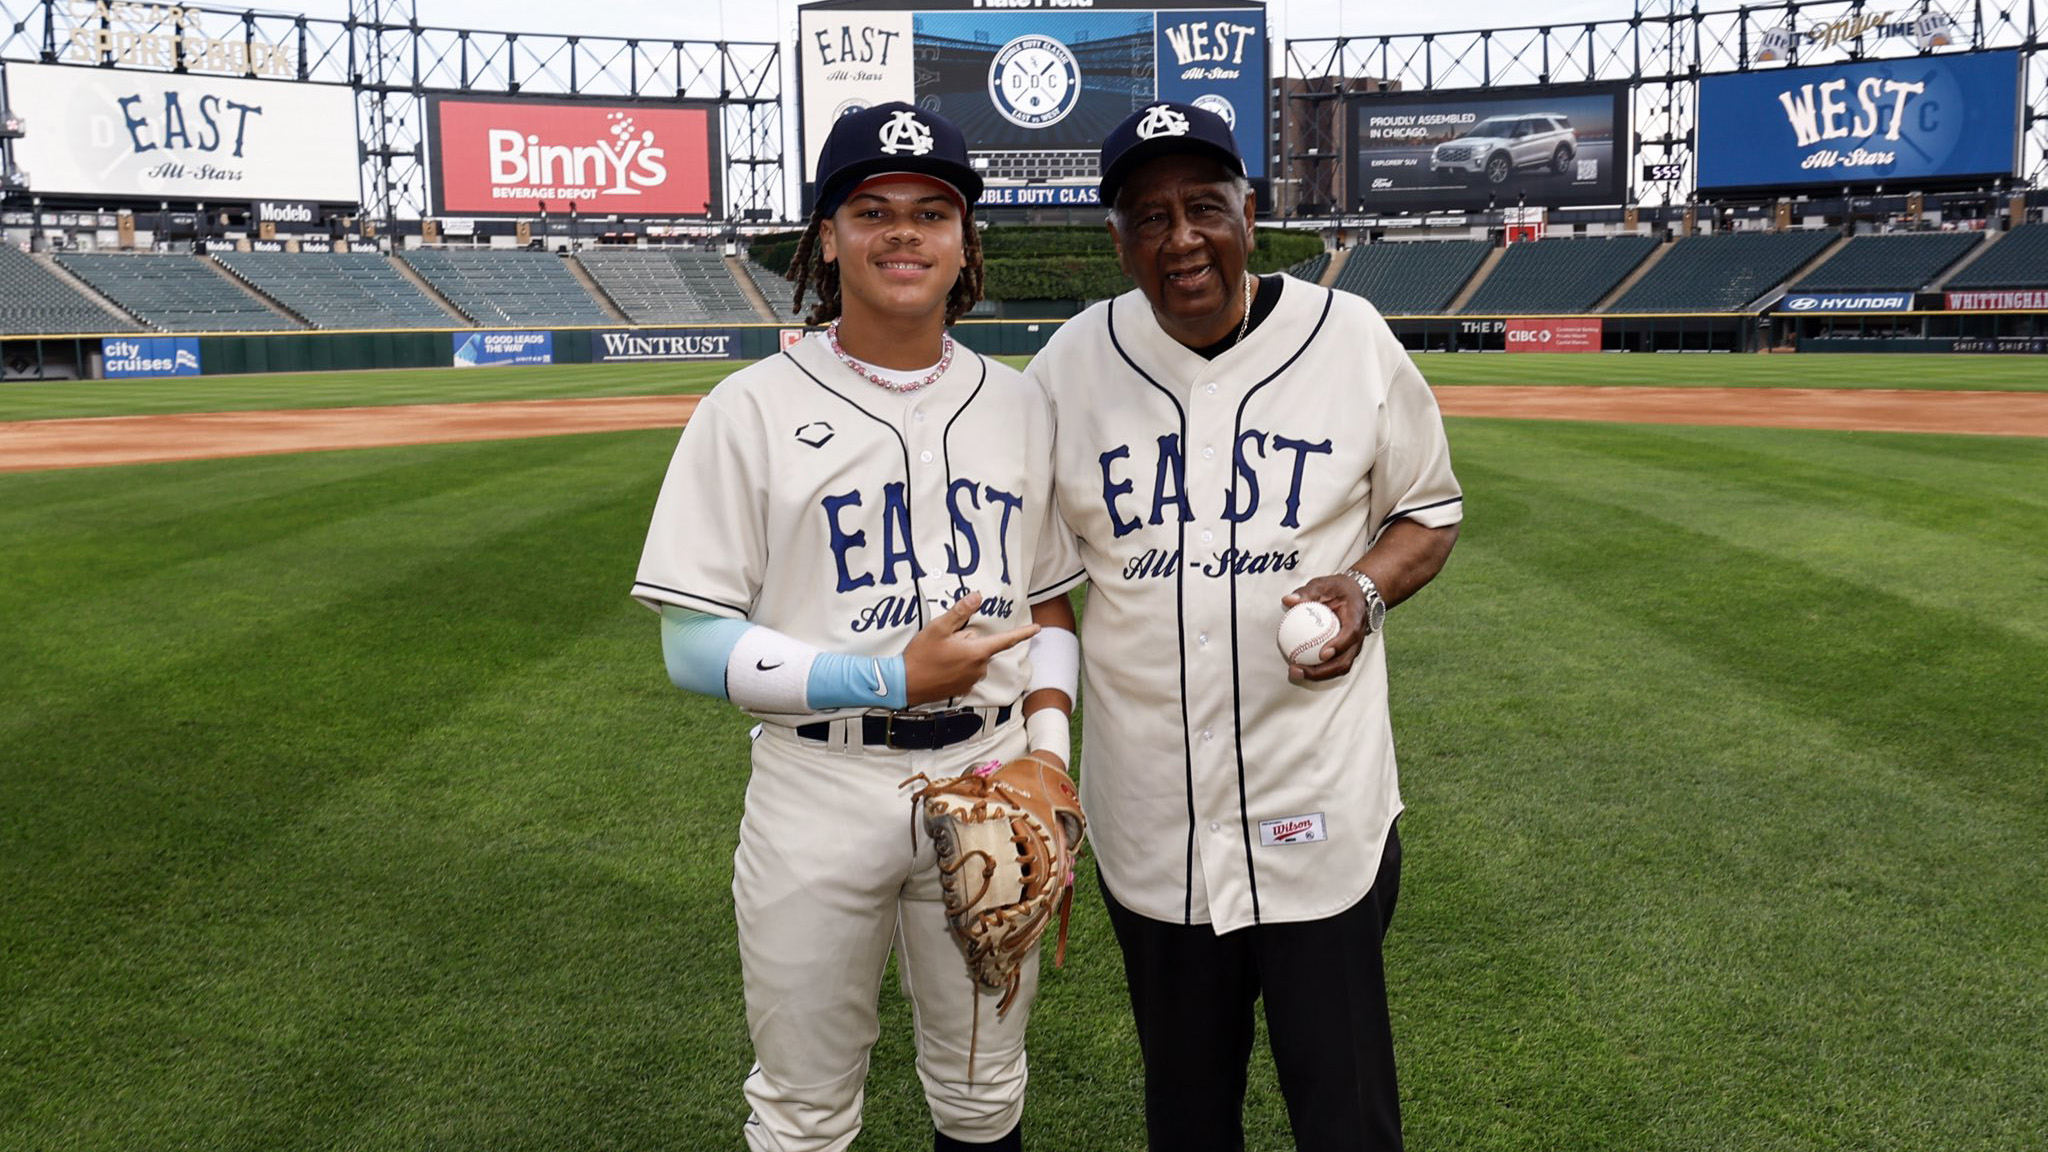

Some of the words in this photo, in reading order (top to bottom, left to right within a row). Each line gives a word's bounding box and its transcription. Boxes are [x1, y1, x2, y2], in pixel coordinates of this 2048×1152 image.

[67, 0, 203, 29] CAESARS
[1808, 10, 1895, 52] Miller
[1877, 21, 1915, 39] TIME
[70, 27, 296, 77] SPORTSBOOK
[815, 25, 900, 66] EAST
[1165, 21, 1256, 66] WEST
[826, 70, 883, 81] All-Stars
[1181, 67, 1240, 80] All-Stars
[1370, 115, 1417, 127] PROUDLY
[1417, 113, 1476, 125] ASSEMBLED
[1778, 77, 1925, 148] WEST
[117, 91, 263, 159] EAST
[1370, 128, 1381, 139] IN
[1801, 148, 1895, 170] All-Stars
[148, 162, 244, 181] All-Stars
[492, 187, 556, 199] BEVERAGE
[557, 188, 598, 200] DEPOT
[1017, 188, 1055, 204] DUTY
[260, 202, 312, 223] Modelo
[1820, 297, 1904, 309] HYUNDAI
[1461, 321, 1491, 333] THE
[1508, 330, 1537, 342] CIBC
[484, 335, 514, 345] GOOD
[514, 334, 545, 344] LEADS
[602, 333, 730, 355] WINTRUST
[1952, 341, 1985, 351] SHIFT
[1997, 341, 2032, 351] SHIFT
[104, 341, 139, 360] city
[484, 344, 503, 354] THE
[503, 344, 525, 353] WAY
[105, 356, 173, 372] cruises
[1098, 429, 1333, 539] EAST
[821, 478, 1024, 594] EAST
[1272, 819, 1313, 836] Wilson
